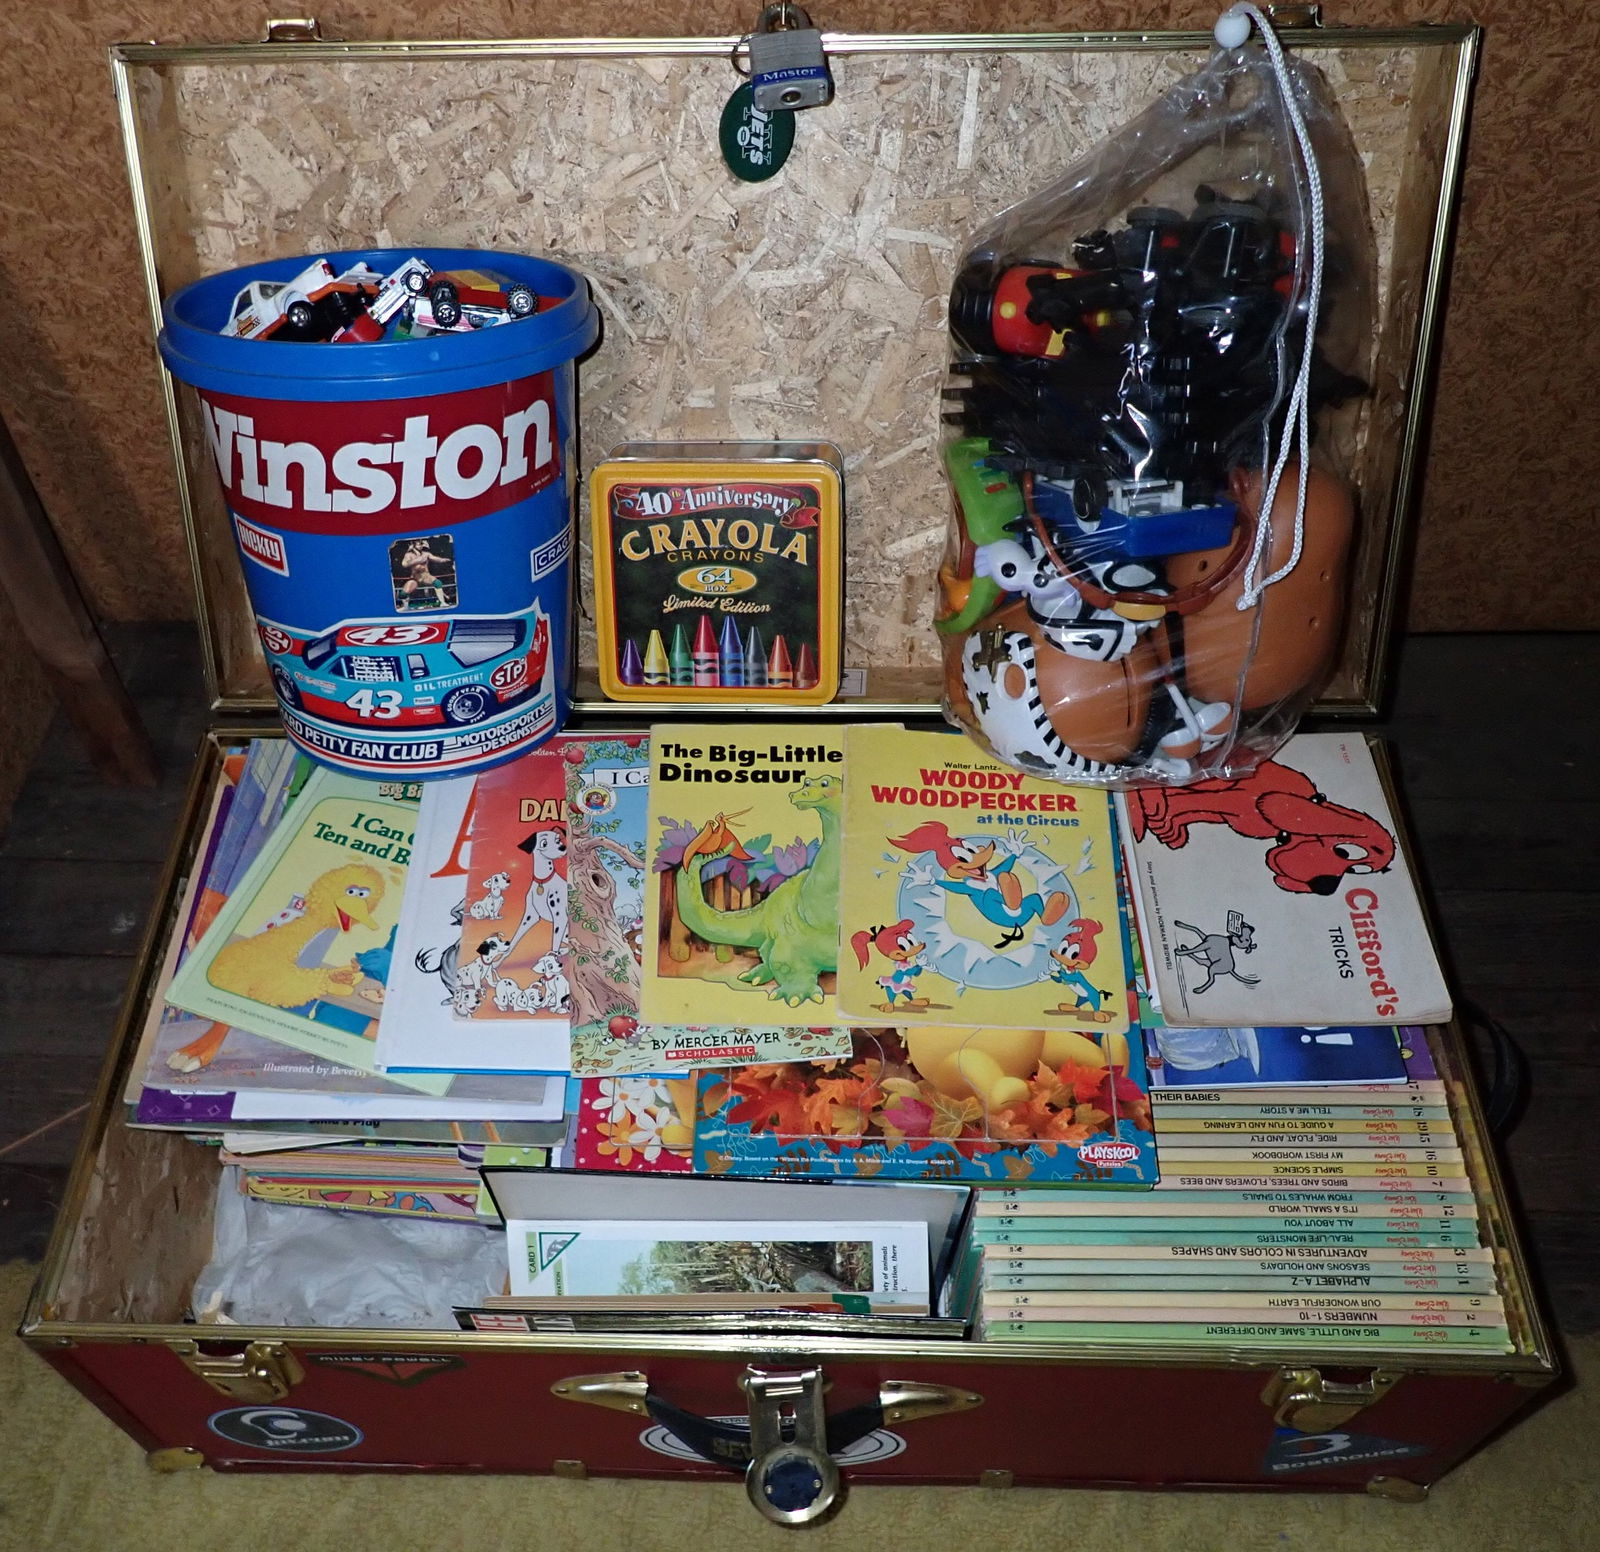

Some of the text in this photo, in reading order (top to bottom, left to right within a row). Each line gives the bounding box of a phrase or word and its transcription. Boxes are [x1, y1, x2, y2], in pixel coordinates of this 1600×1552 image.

[763, 67, 817, 82] Master
[750, 103, 769, 166] JETS
[680, 486, 794, 517] Anniversary
[621, 518, 808, 565] CRAYOLA
[667, 550, 764, 564] CRAYONS
[696, 567, 734, 585] 64
[704, 585, 728, 593] BOX
[663, 594, 772, 614] Limited Edition
[348, 625, 430, 644] 43
[414, 683, 436, 692] OIL
[437, 673, 484, 689] TREATMENT
[494, 660, 523, 686] STP
[346, 689, 403, 719] 43
[281, 708, 438, 760] ARD PETTY FAN CLUB
[457, 703, 547, 747] MOTORSPORTS
[482, 725, 531, 753] DESIGNS
[660, 743, 843, 767] The Big-Little
[659, 763, 806, 784] Dinosaur
[944, 761, 998, 771] Walter Lantz
[611, 772, 619, 785] I
[919, 768, 1026, 791] WOODY
[379, 783, 423, 800] Big Bi
[871, 785, 1078, 812] WOODPECKER
[351, 813, 363, 828] I
[364, 816, 404, 841] Can
[976, 813, 1080, 827] at the Circus
[313, 822, 348, 846] Ten
[351, 837, 393, 860] and
[1157, 915, 1167, 942] NORMAN
[1163, 943, 1173, 971] BRIDWELL
[1344, 887, 1400, 1017] Clifford's
[1328, 926, 1354, 980] TRICKS
[652, 1032, 781, 1051] BY MERCER MAYER
[677, 1046, 755, 1059] SCHOLASTIC
[263, 1062, 315, 1075] Illustrated
[316, 1065, 330, 1077] by
[1080, 1146, 1139, 1160] PLAYSKOOL
[1172, 1247, 1213, 1255] SHAPES
[1240, 1248, 1283, 1256] COLORS
[1297, 1249, 1367, 1257] ADVENTURES
[528, 1251, 537, 1273] CARD
[1261, 1262, 1304, 1270] HOLIDAYS
[1316, 1277, 1370, 1286] ALPHABET
[1324, 1312, 1377, 1320] NUMBERS
[1206, 1326, 1255, 1335] DIFFERENT
[1258, 1327, 1276, 1335] AND
[1364, 1329, 1379, 1337] BIG
[1272, 1447, 1410, 1471] Boathouse
